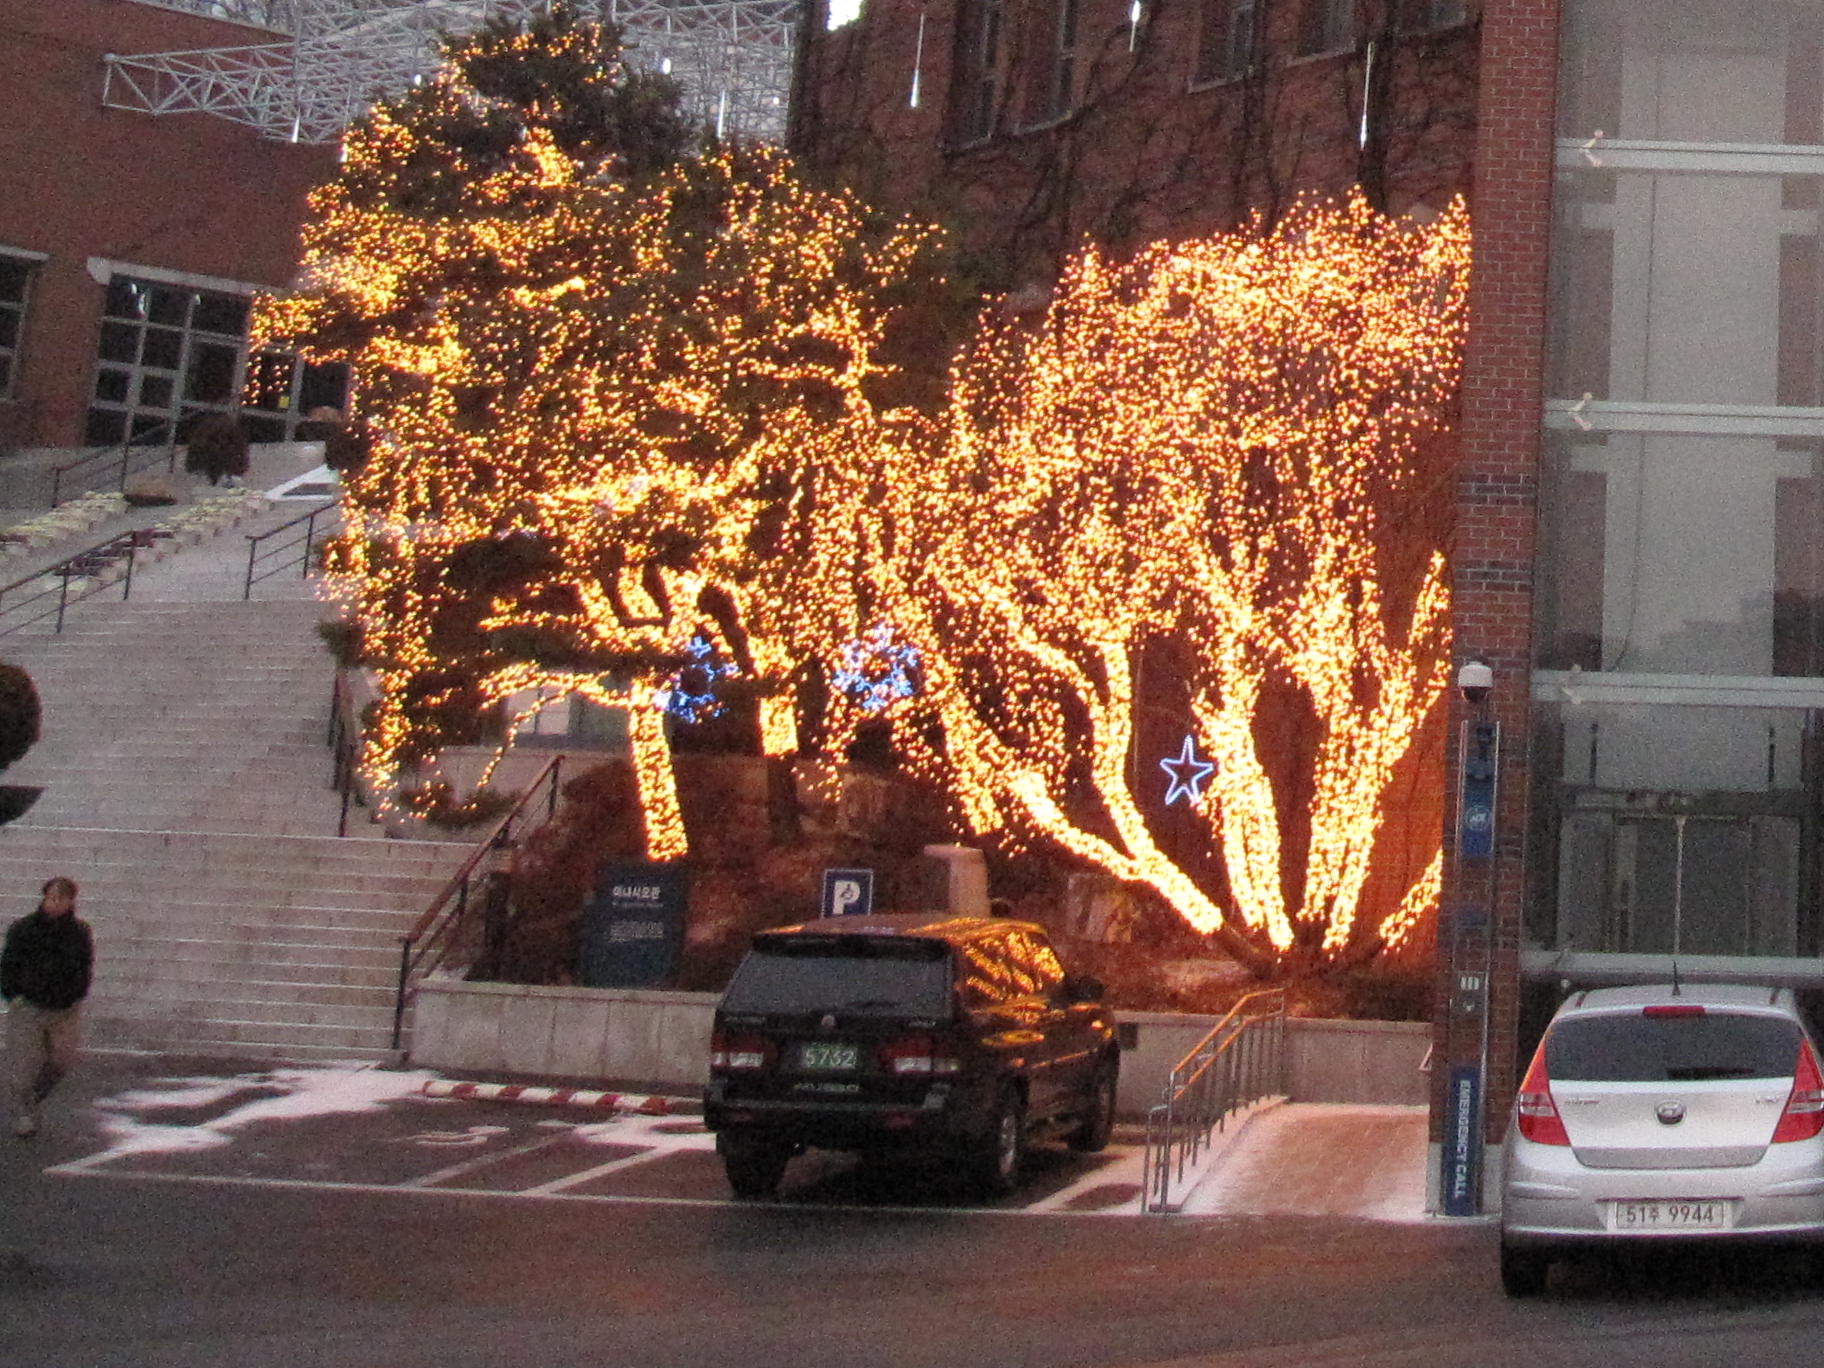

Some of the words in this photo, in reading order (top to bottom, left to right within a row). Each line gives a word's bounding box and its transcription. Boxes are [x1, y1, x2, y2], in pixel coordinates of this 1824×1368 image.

[832, 880, 861, 915] P
[804, 1046, 857, 1069] 5732
[1457, 1079, 1471, 1162] EMERGENCY
[1454, 1164, 1467, 1199] CALL
[1669, 1203, 1715, 1223] 9944
